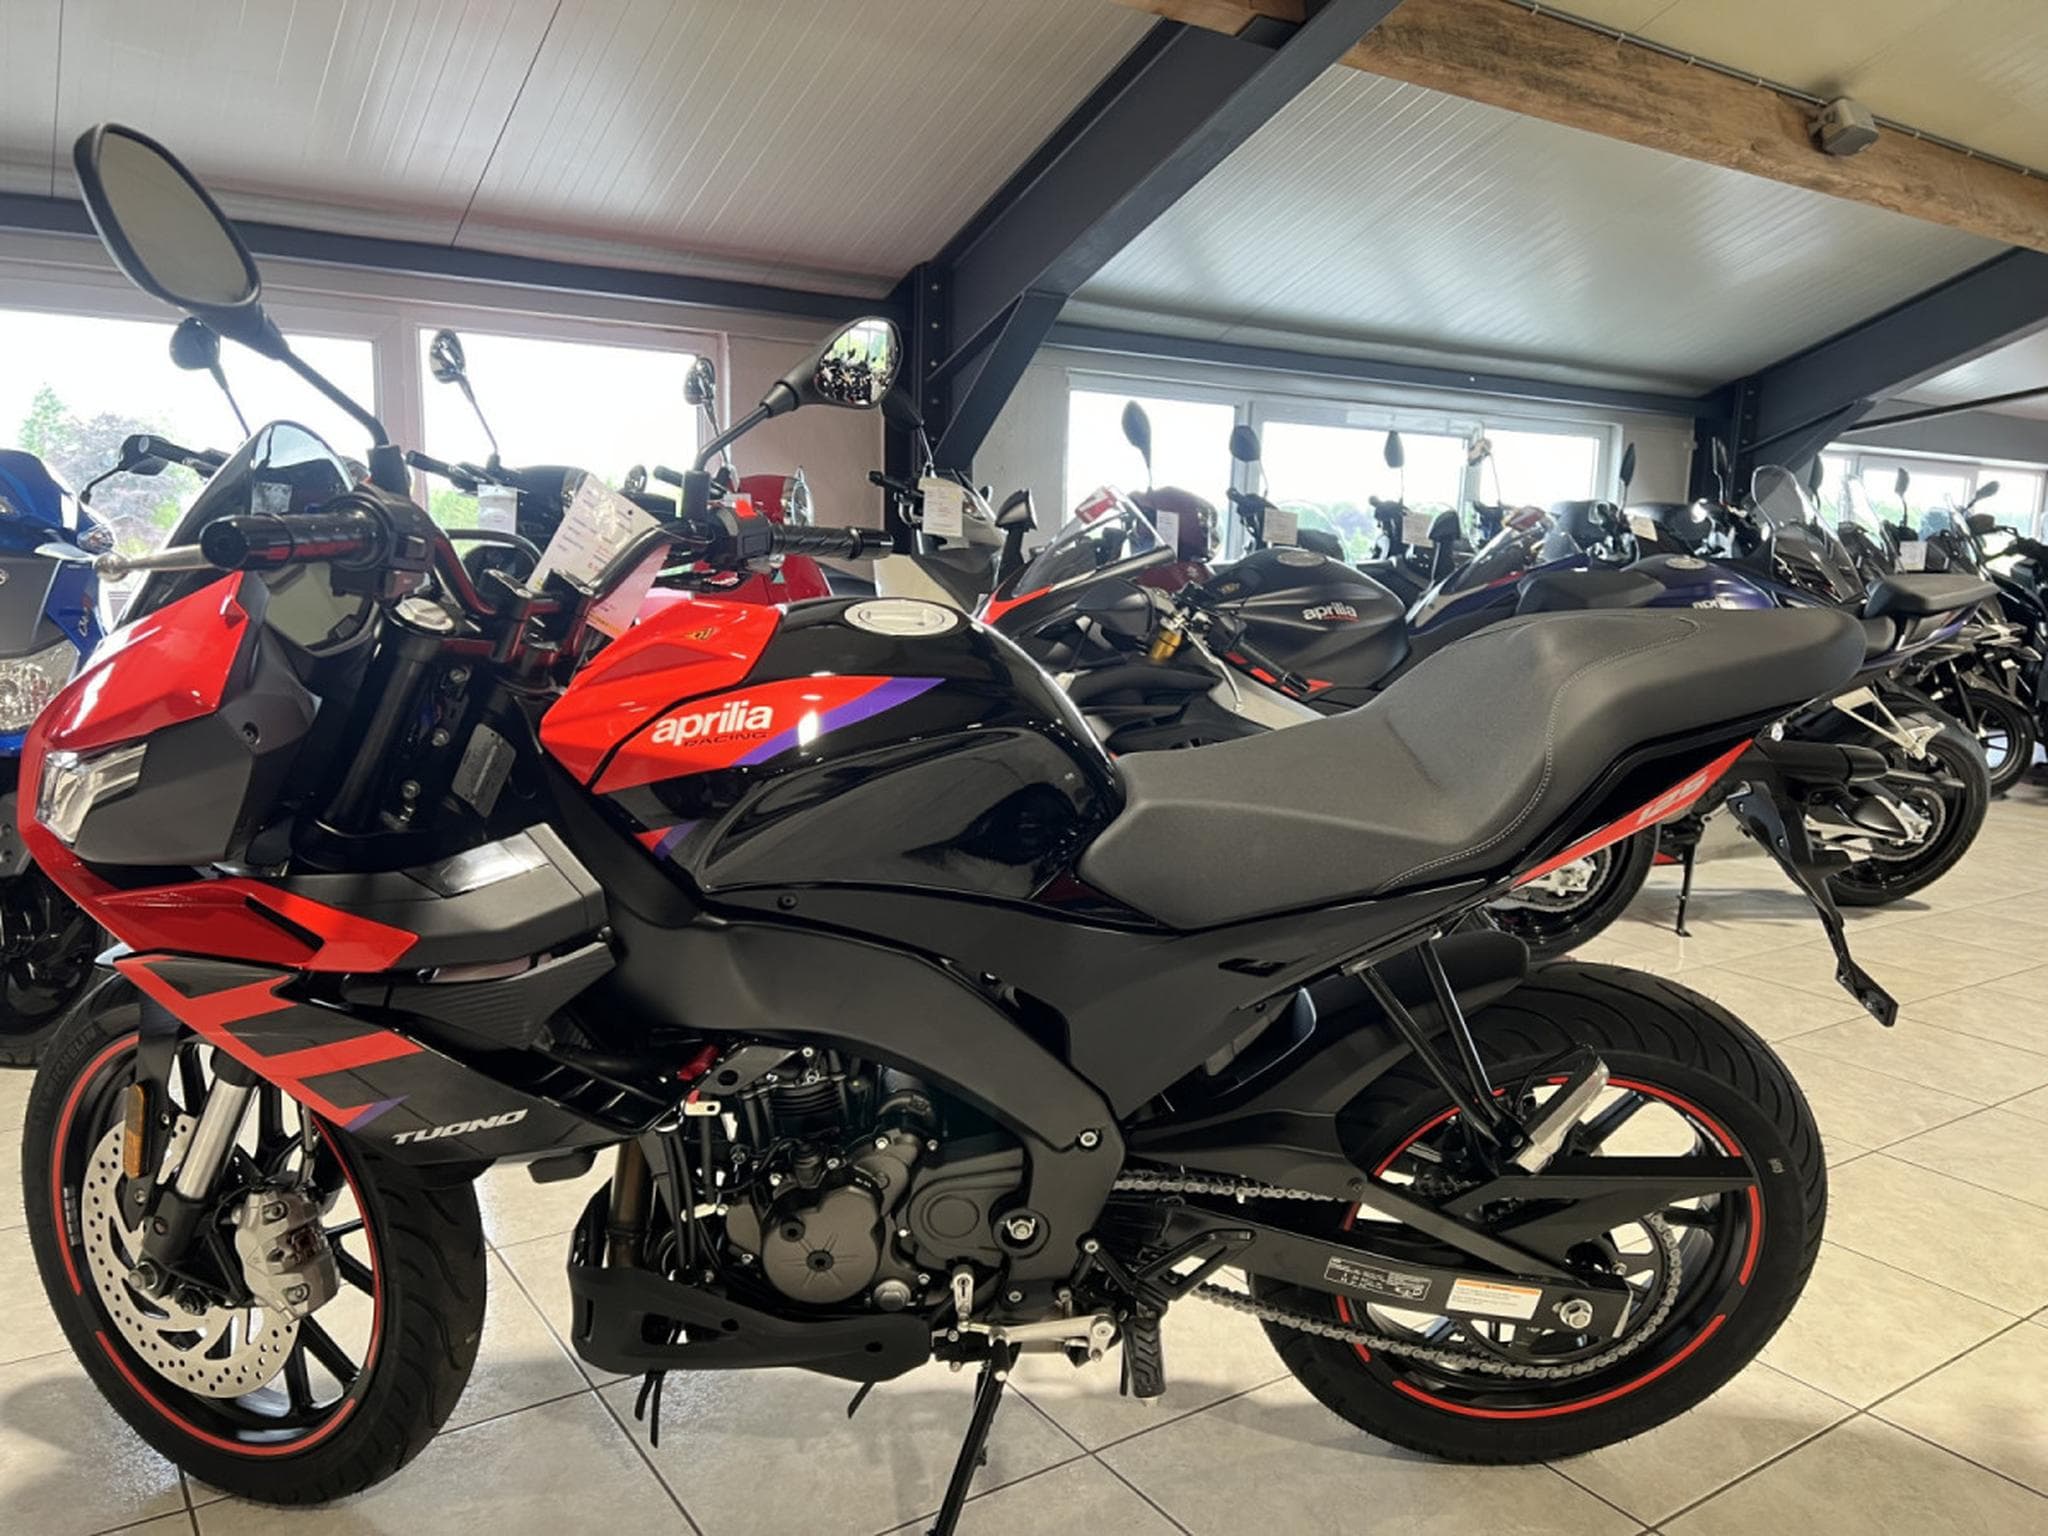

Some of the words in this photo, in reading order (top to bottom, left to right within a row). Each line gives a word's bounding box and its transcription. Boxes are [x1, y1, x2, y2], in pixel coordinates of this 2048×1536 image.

[1302, 601, 1358, 620] aprilia
[652, 700, 773, 746] aprilia
[684, 731, 768, 748] RACING
[1634, 770, 1709, 825] 125
[392, 1108, 529, 1145] TUONO
